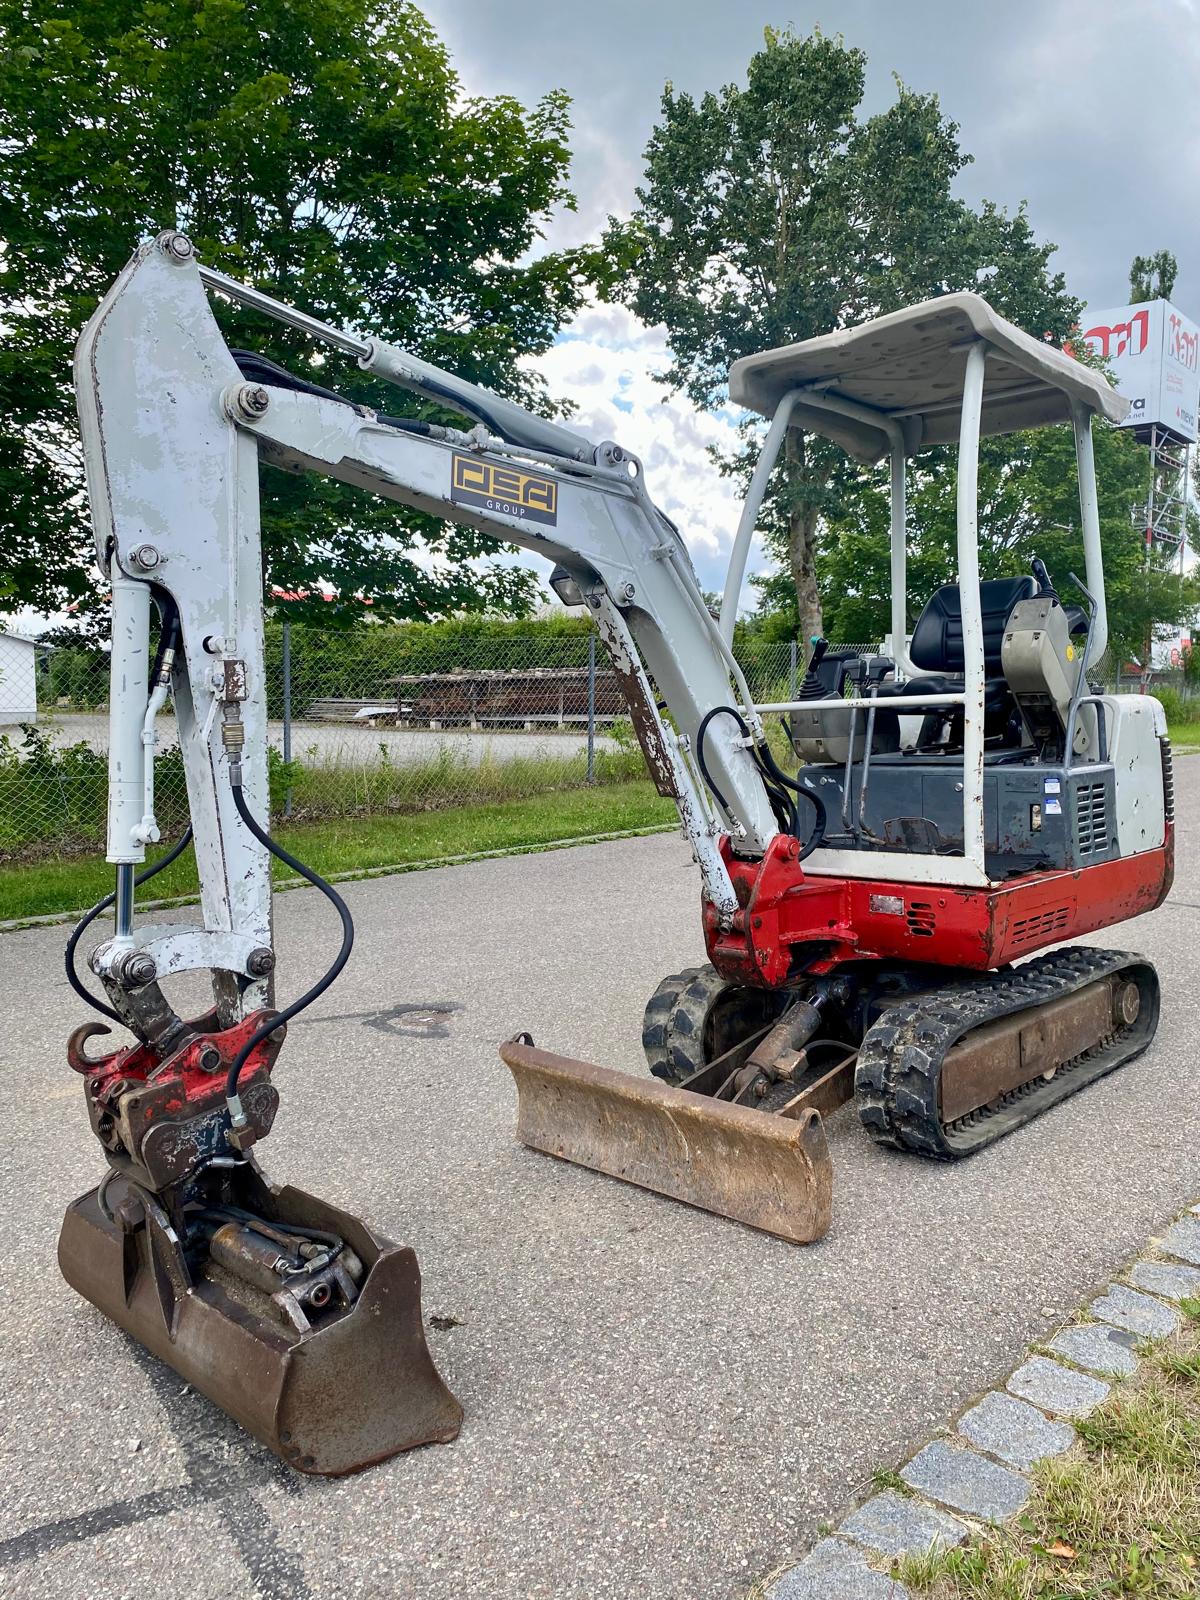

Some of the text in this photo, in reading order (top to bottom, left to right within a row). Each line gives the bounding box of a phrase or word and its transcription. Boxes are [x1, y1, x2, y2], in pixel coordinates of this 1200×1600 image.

[1062, 309, 1149, 359] arl
[1168, 313, 1199, 374] Karl
[486, 499, 526, 517] GROUP
